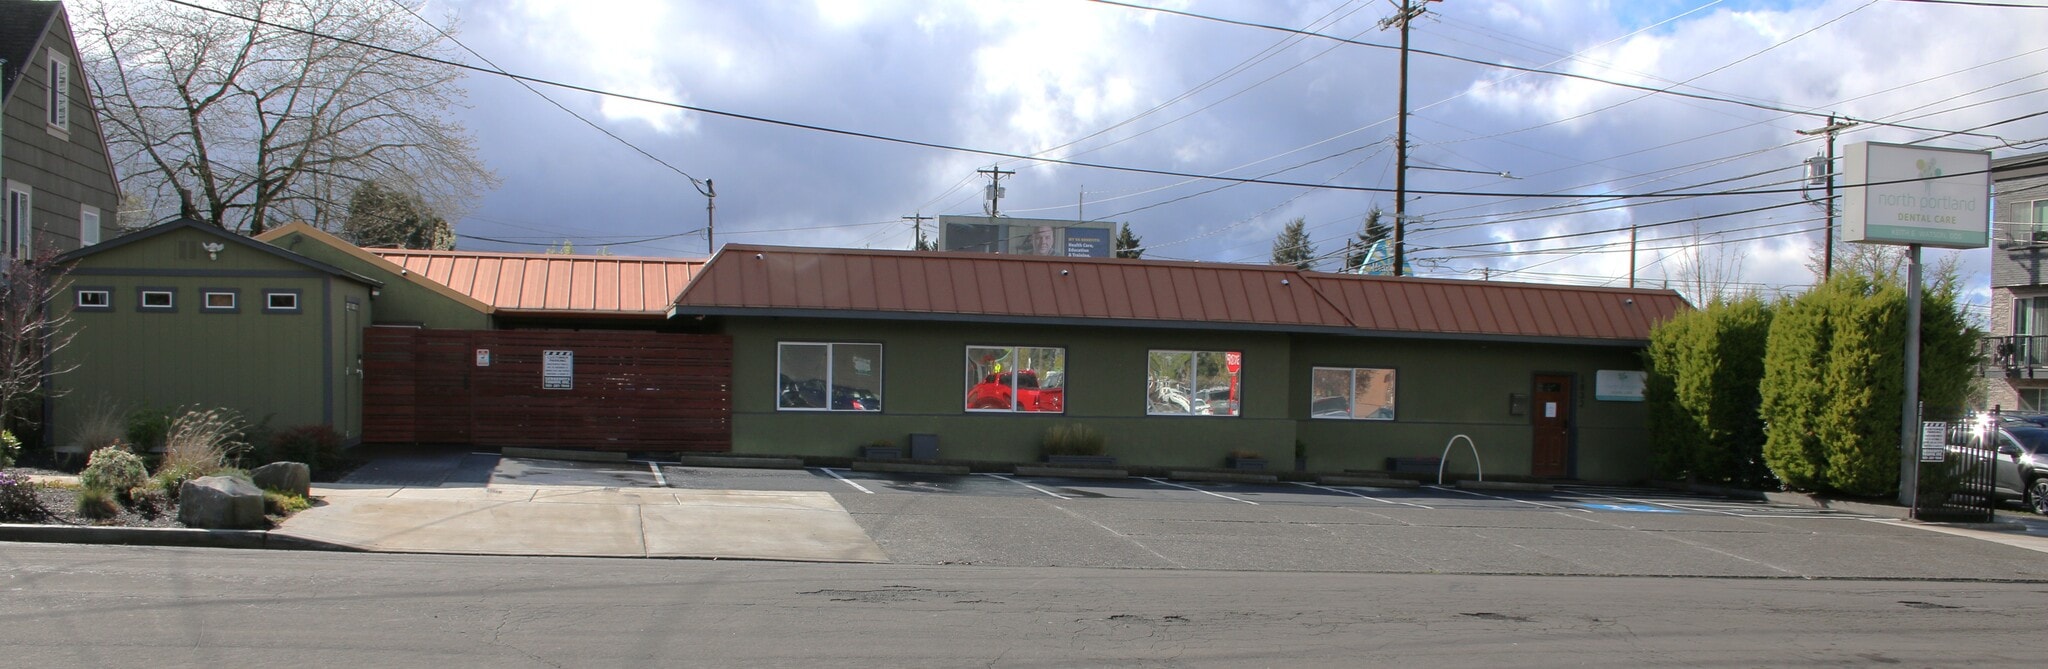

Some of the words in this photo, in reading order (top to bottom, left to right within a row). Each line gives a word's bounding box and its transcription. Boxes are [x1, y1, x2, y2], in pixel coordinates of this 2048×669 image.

[1878, 193, 1916, 207] north
[1920, 195, 1976, 212] portland
[1898, 212, 1931, 223] DENTAL
[1934, 215, 1957, 224] CARE
